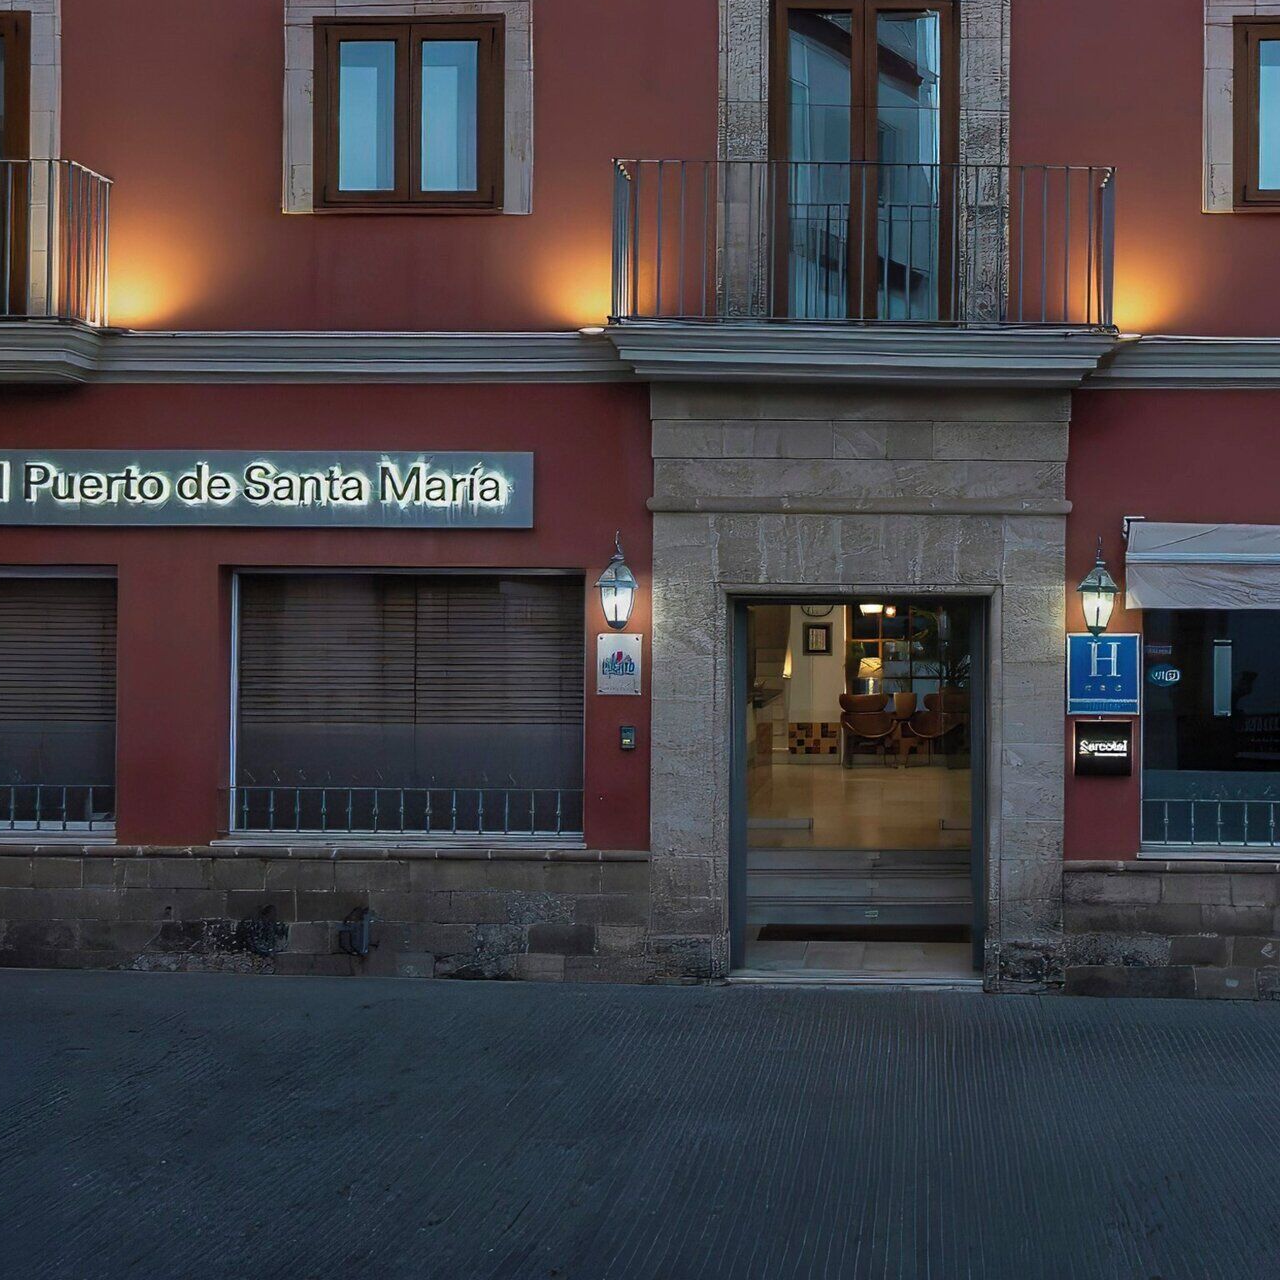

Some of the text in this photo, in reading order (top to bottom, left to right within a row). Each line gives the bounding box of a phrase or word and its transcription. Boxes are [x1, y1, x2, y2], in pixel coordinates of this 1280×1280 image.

[23, 461, 166, 503] Puerto
[176, 462, 233, 502] de
[243, 463, 365, 503] Santa
[379, 461, 502, 503] María
[1087, 641, 1122, 677] H
